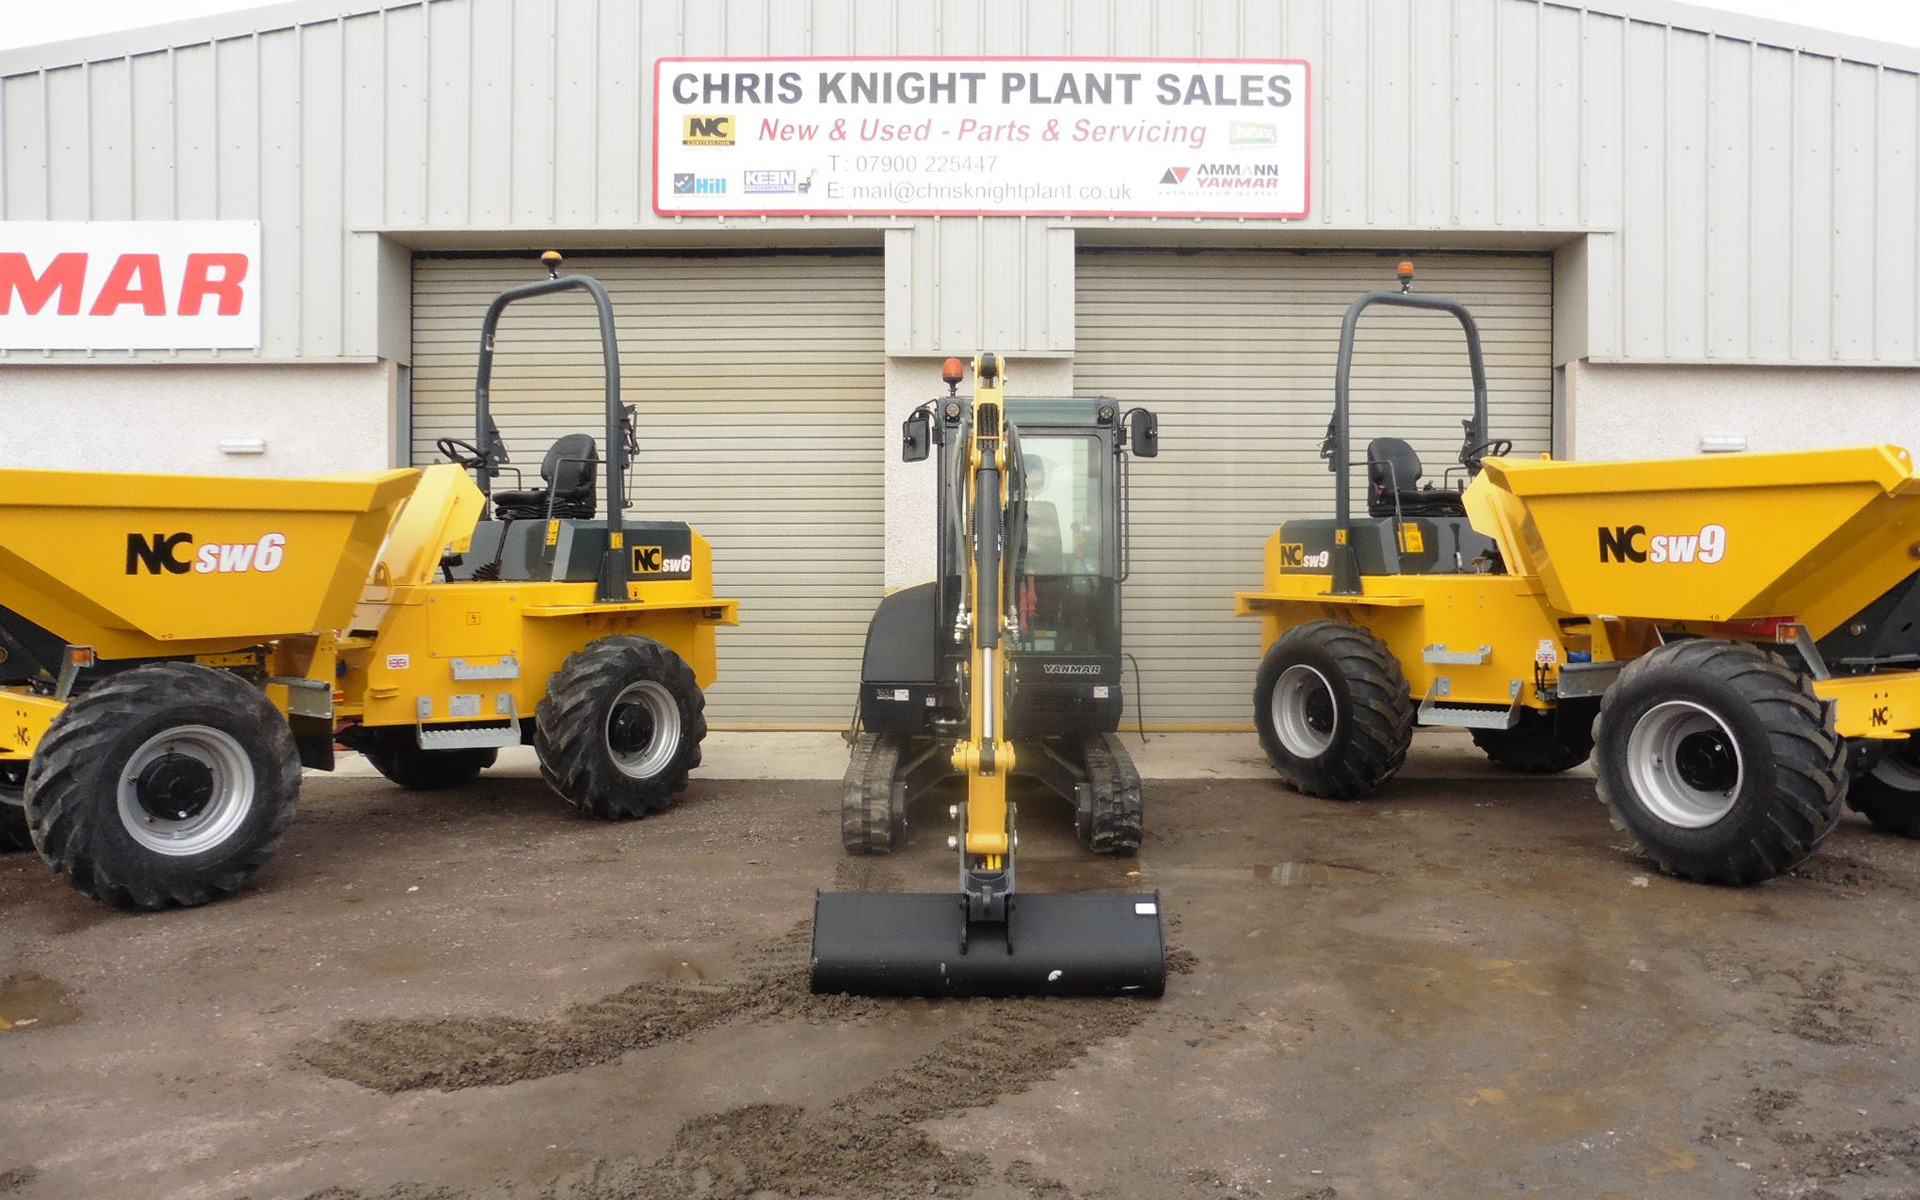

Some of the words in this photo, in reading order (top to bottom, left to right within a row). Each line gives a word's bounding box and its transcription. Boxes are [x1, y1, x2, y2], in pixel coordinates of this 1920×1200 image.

[672, 72, 803, 105] CHRIS
[819, 72, 985, 105] KNIGHT
[1001, 72, 1141, 105] PLANT
[1156, 74, 1292, 107] SALES
[690, 117, 728, 138] NC
[759, 118, 818, 141] New
[829, 118, 847, 141] &
[860, 118, 931, 141] Used
[957, 119, 1030, 142] Parts
[1042, 119, 1060, 142] &
[1072, 119, 1206, 150] Servicing
[829, 156, 849, 172] T:
[856, 156, 917, 172] 07900
[925, 156, 997, 172] 225447
[1197, 164, 1278, 176] AMMANN
[696, 178, 726, 194] Hill
[1197, 178, 1278, 188] YANMAR
[828, 182, 845, 199] E:
[853, 182, 1131, 203] mail@chrisknightplant.co.uk
[0, 252, 248, 316] MAR
[1043, 664, 1101, 674] YANMAR
